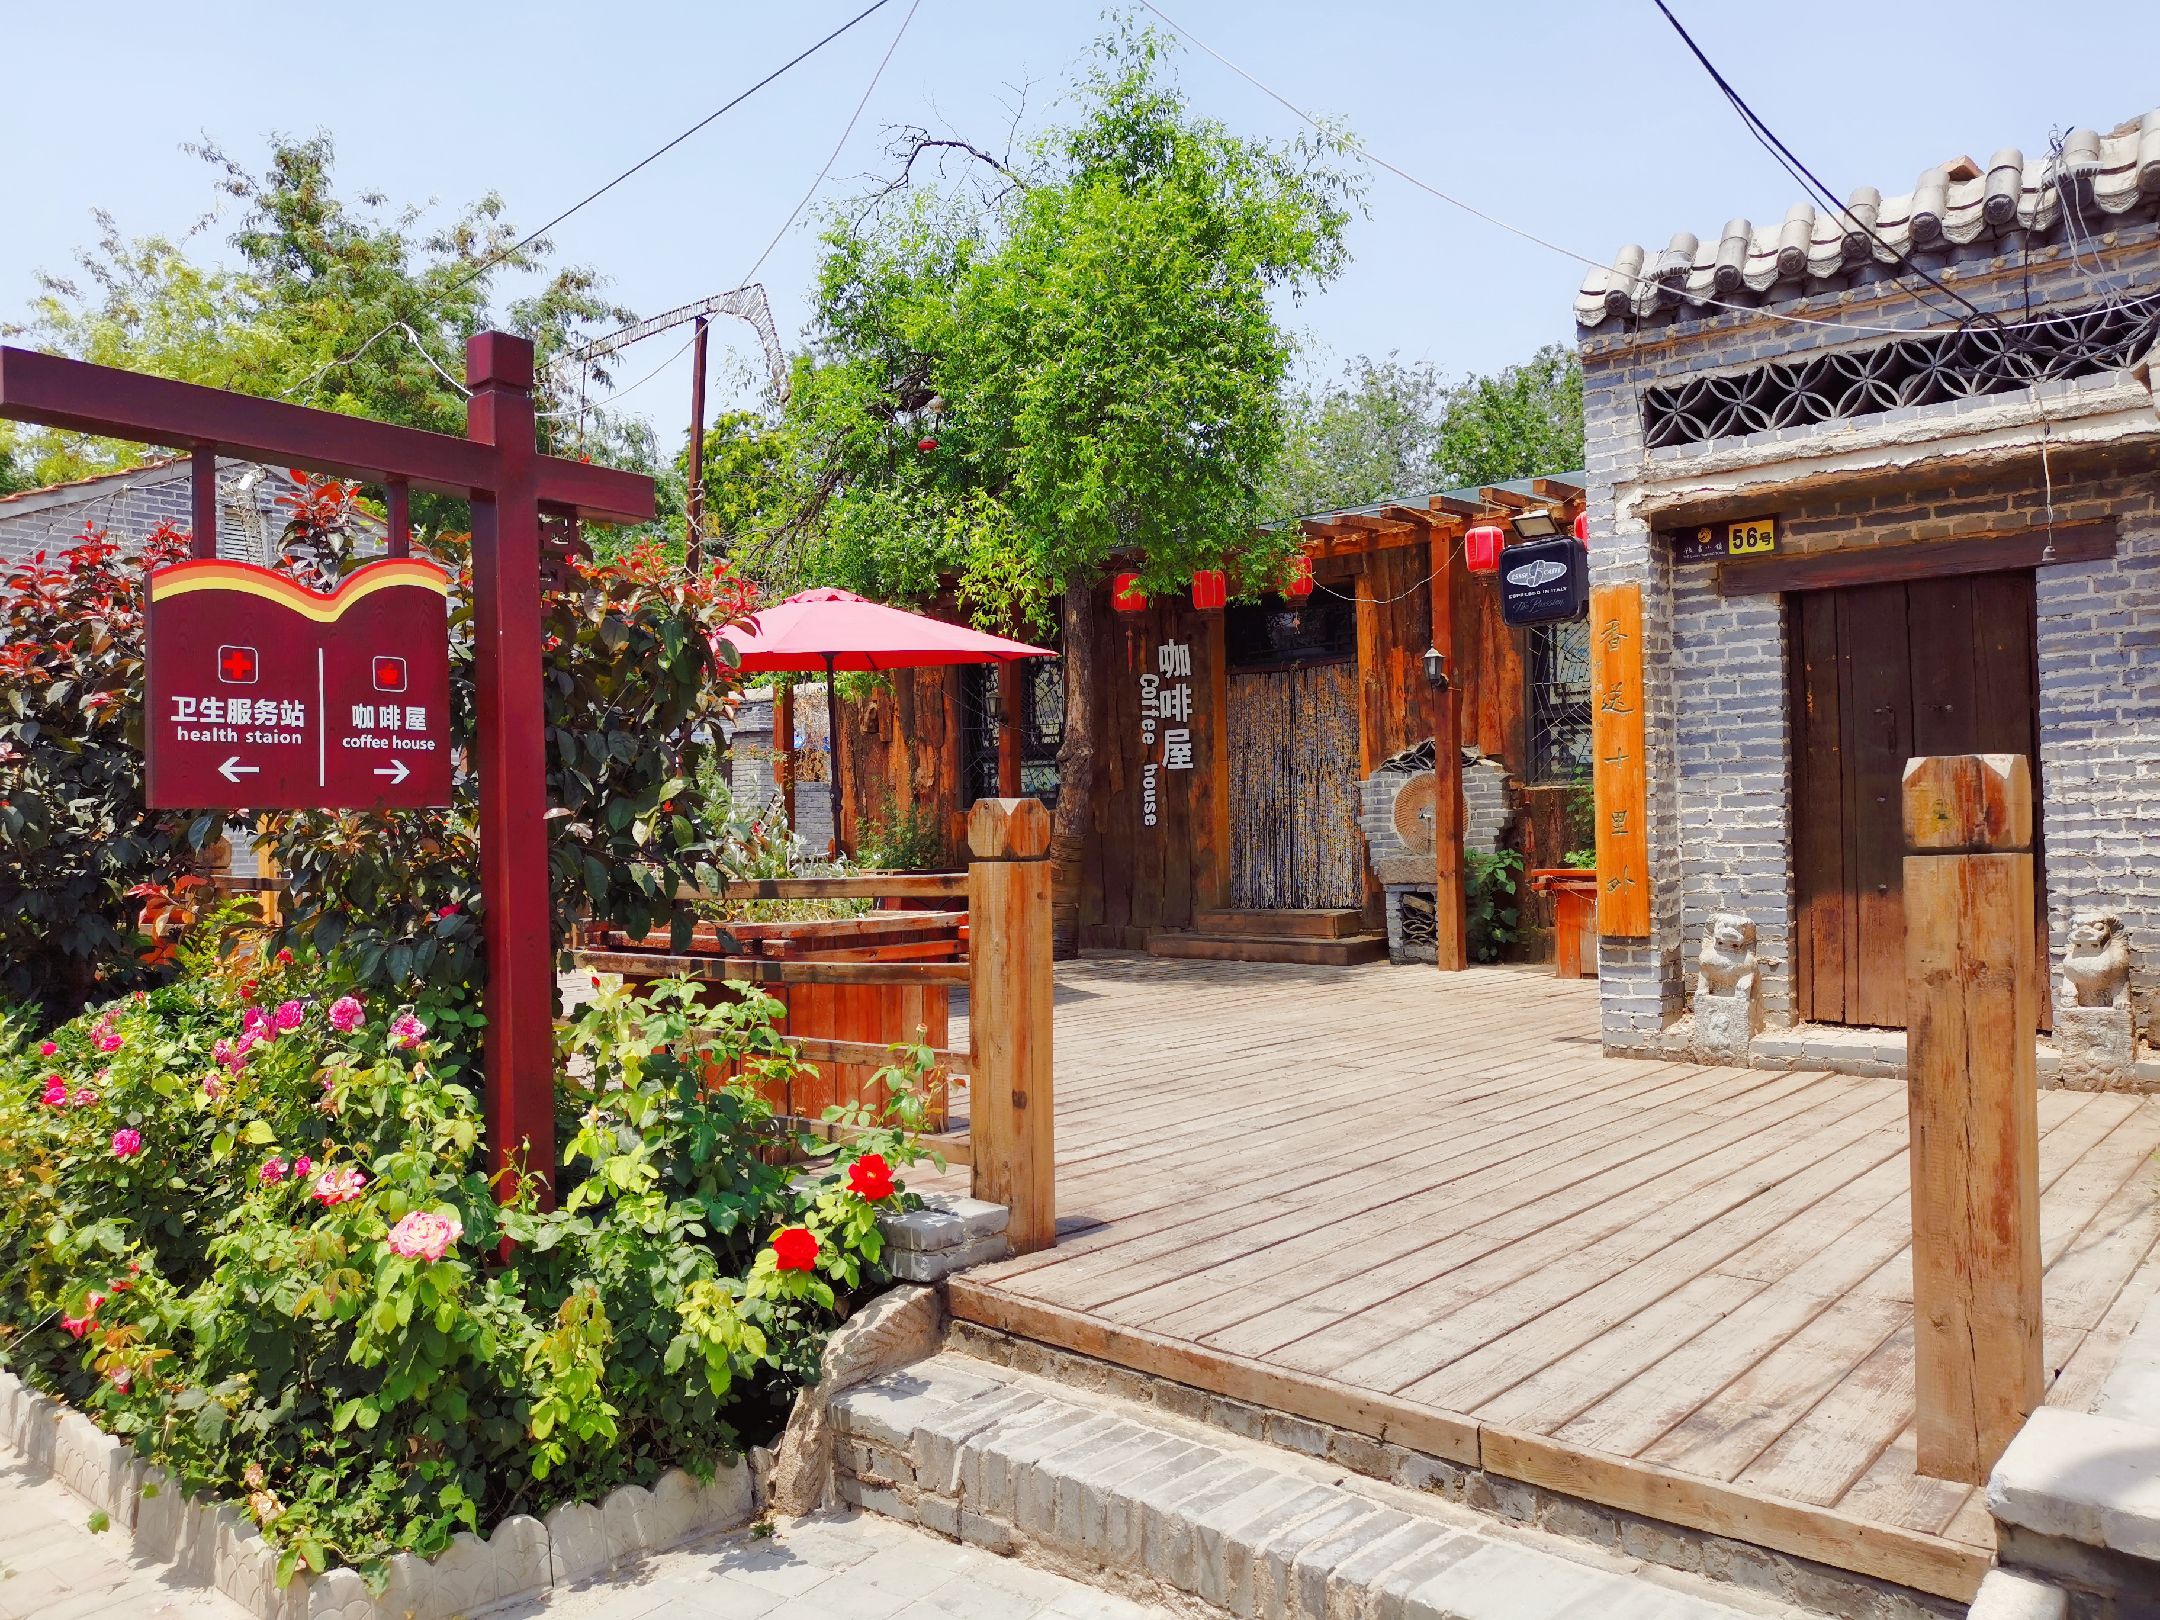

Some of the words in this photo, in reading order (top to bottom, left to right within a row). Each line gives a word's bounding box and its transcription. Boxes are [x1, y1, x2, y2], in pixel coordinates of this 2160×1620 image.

[1732, 526, 1773, 550] 56号
[1550, 586, 1567, 594] ITALY
[170, 696, 305, 728] 卫生服务站
[351, 703, 427, 731] 咖啡屋
[1140, 673, 1160, 745] Coffee
[1158, 638, 1194, 770] 咖啡屋
[177, 726, 239, 743] health
[245, 728, 302, 744] staion
[342, 735, 389, 749] coffee
[392, 736, 436, 750] house
[1143, 763, 1159, 827] house
